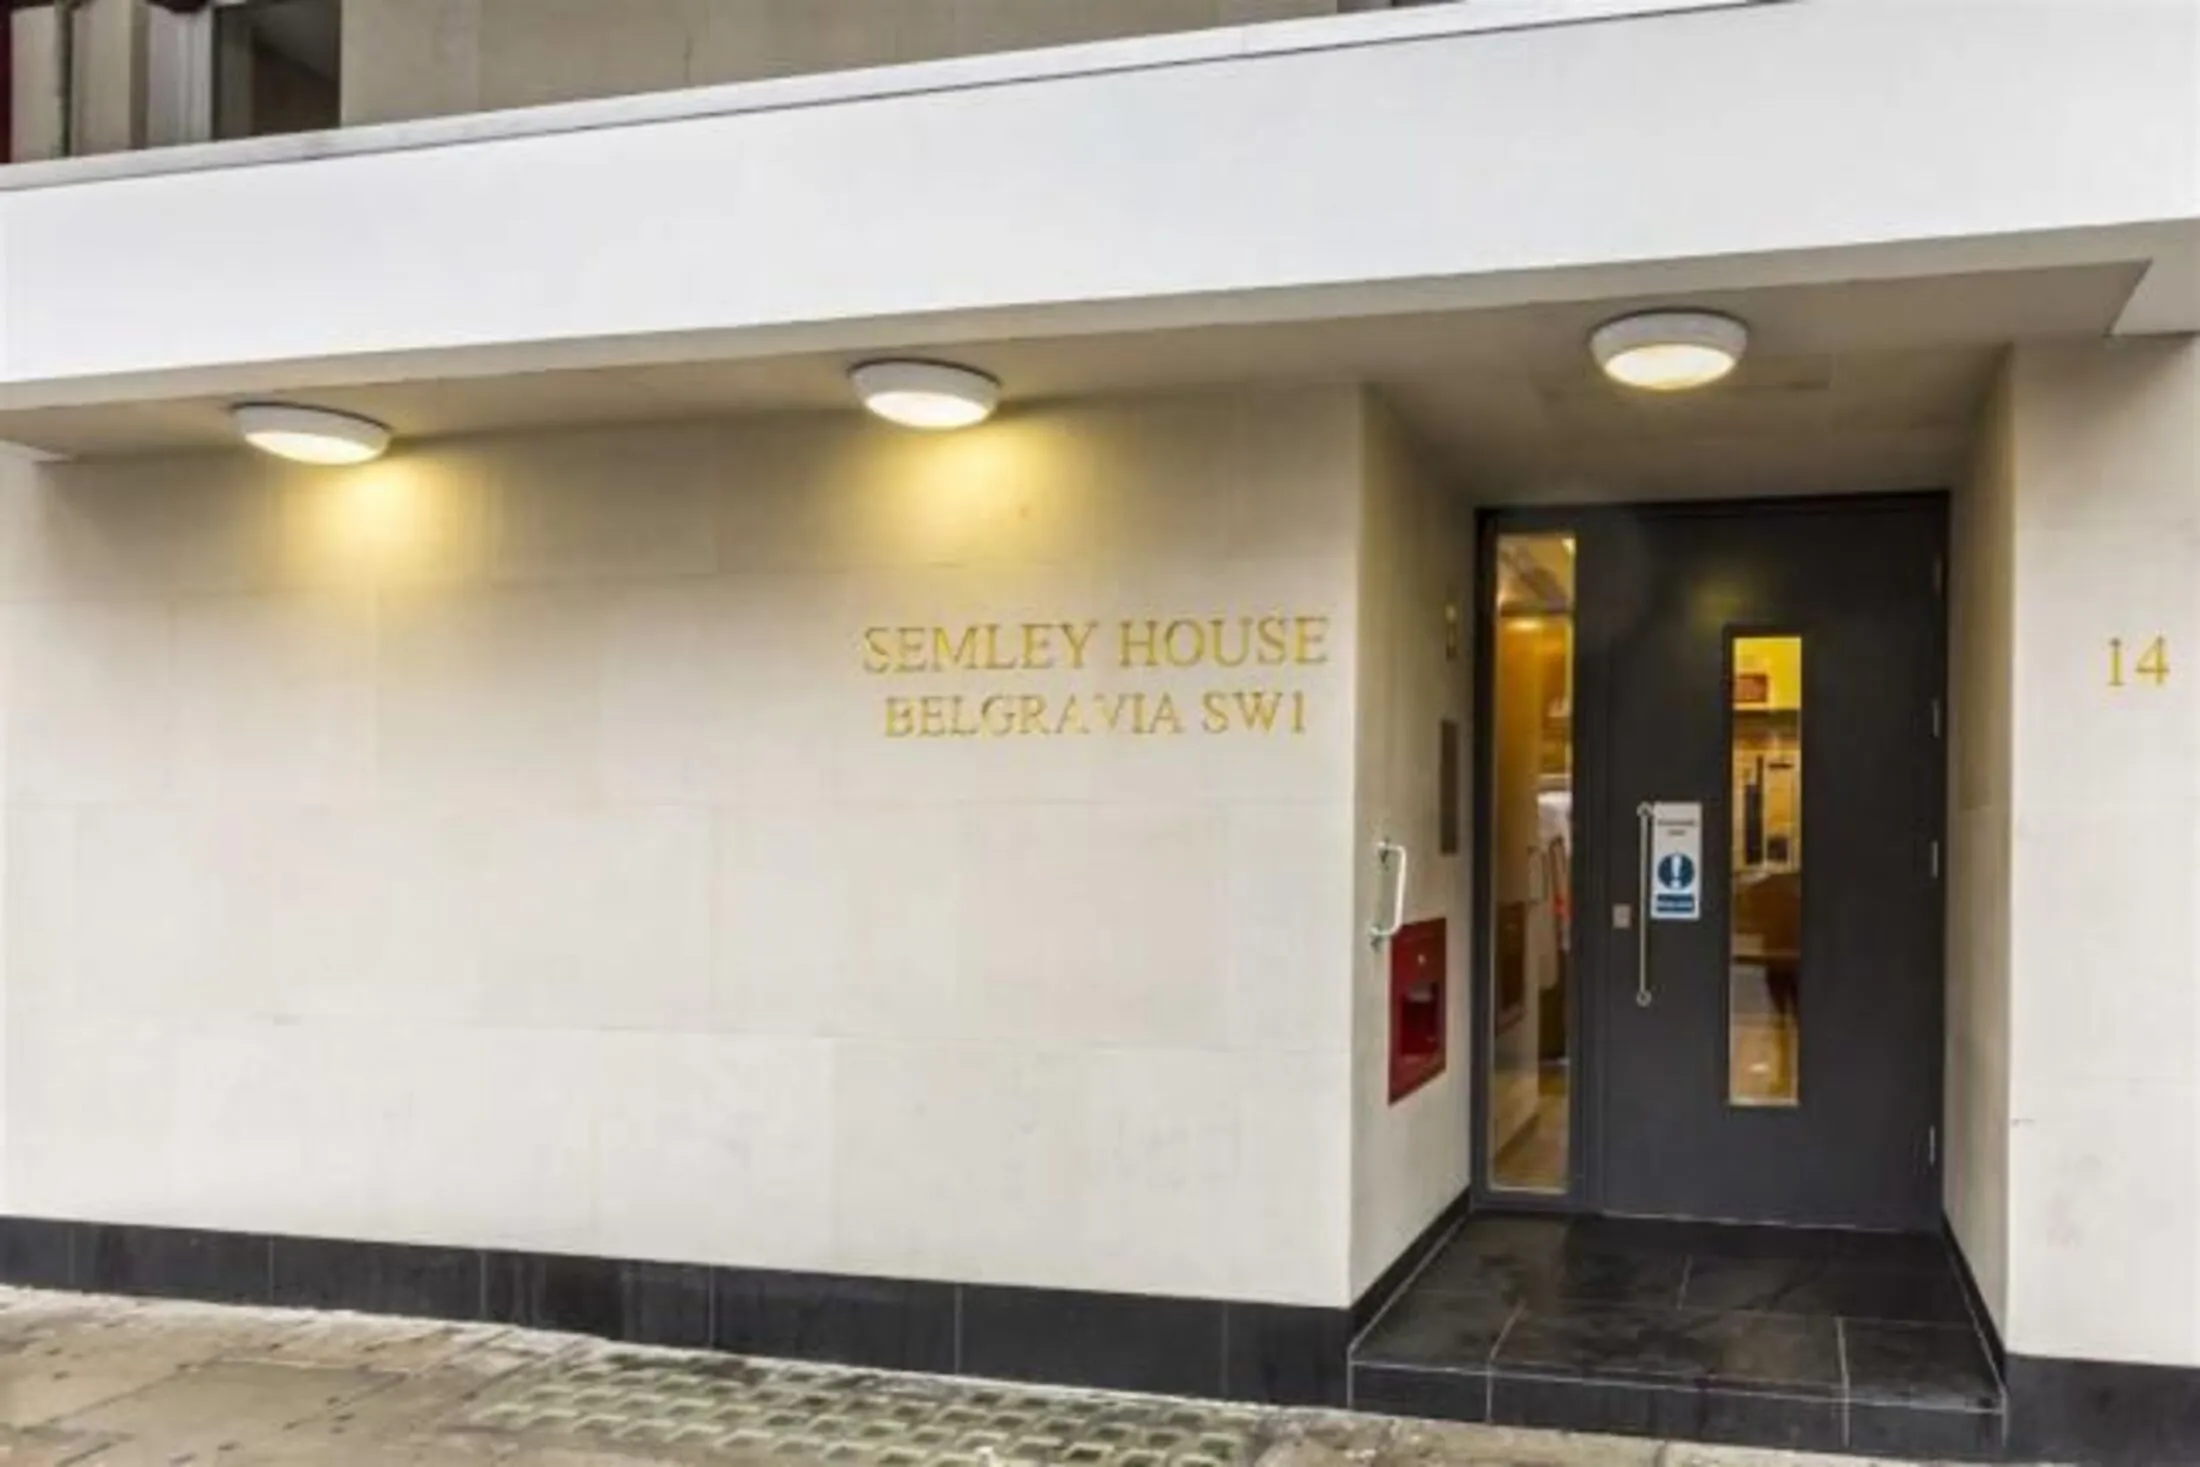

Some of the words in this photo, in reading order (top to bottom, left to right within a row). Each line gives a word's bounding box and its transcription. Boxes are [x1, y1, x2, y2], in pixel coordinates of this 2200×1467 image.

[862, 620, 1098, 674] SEMLEY
[1118, 616, 1329, 667] HOUSE
[2106, 636, 2171, 687] 14
[885, 692, 1187, 738] BELGRAVIA
[1201, 689, 1307, 735] SW1
